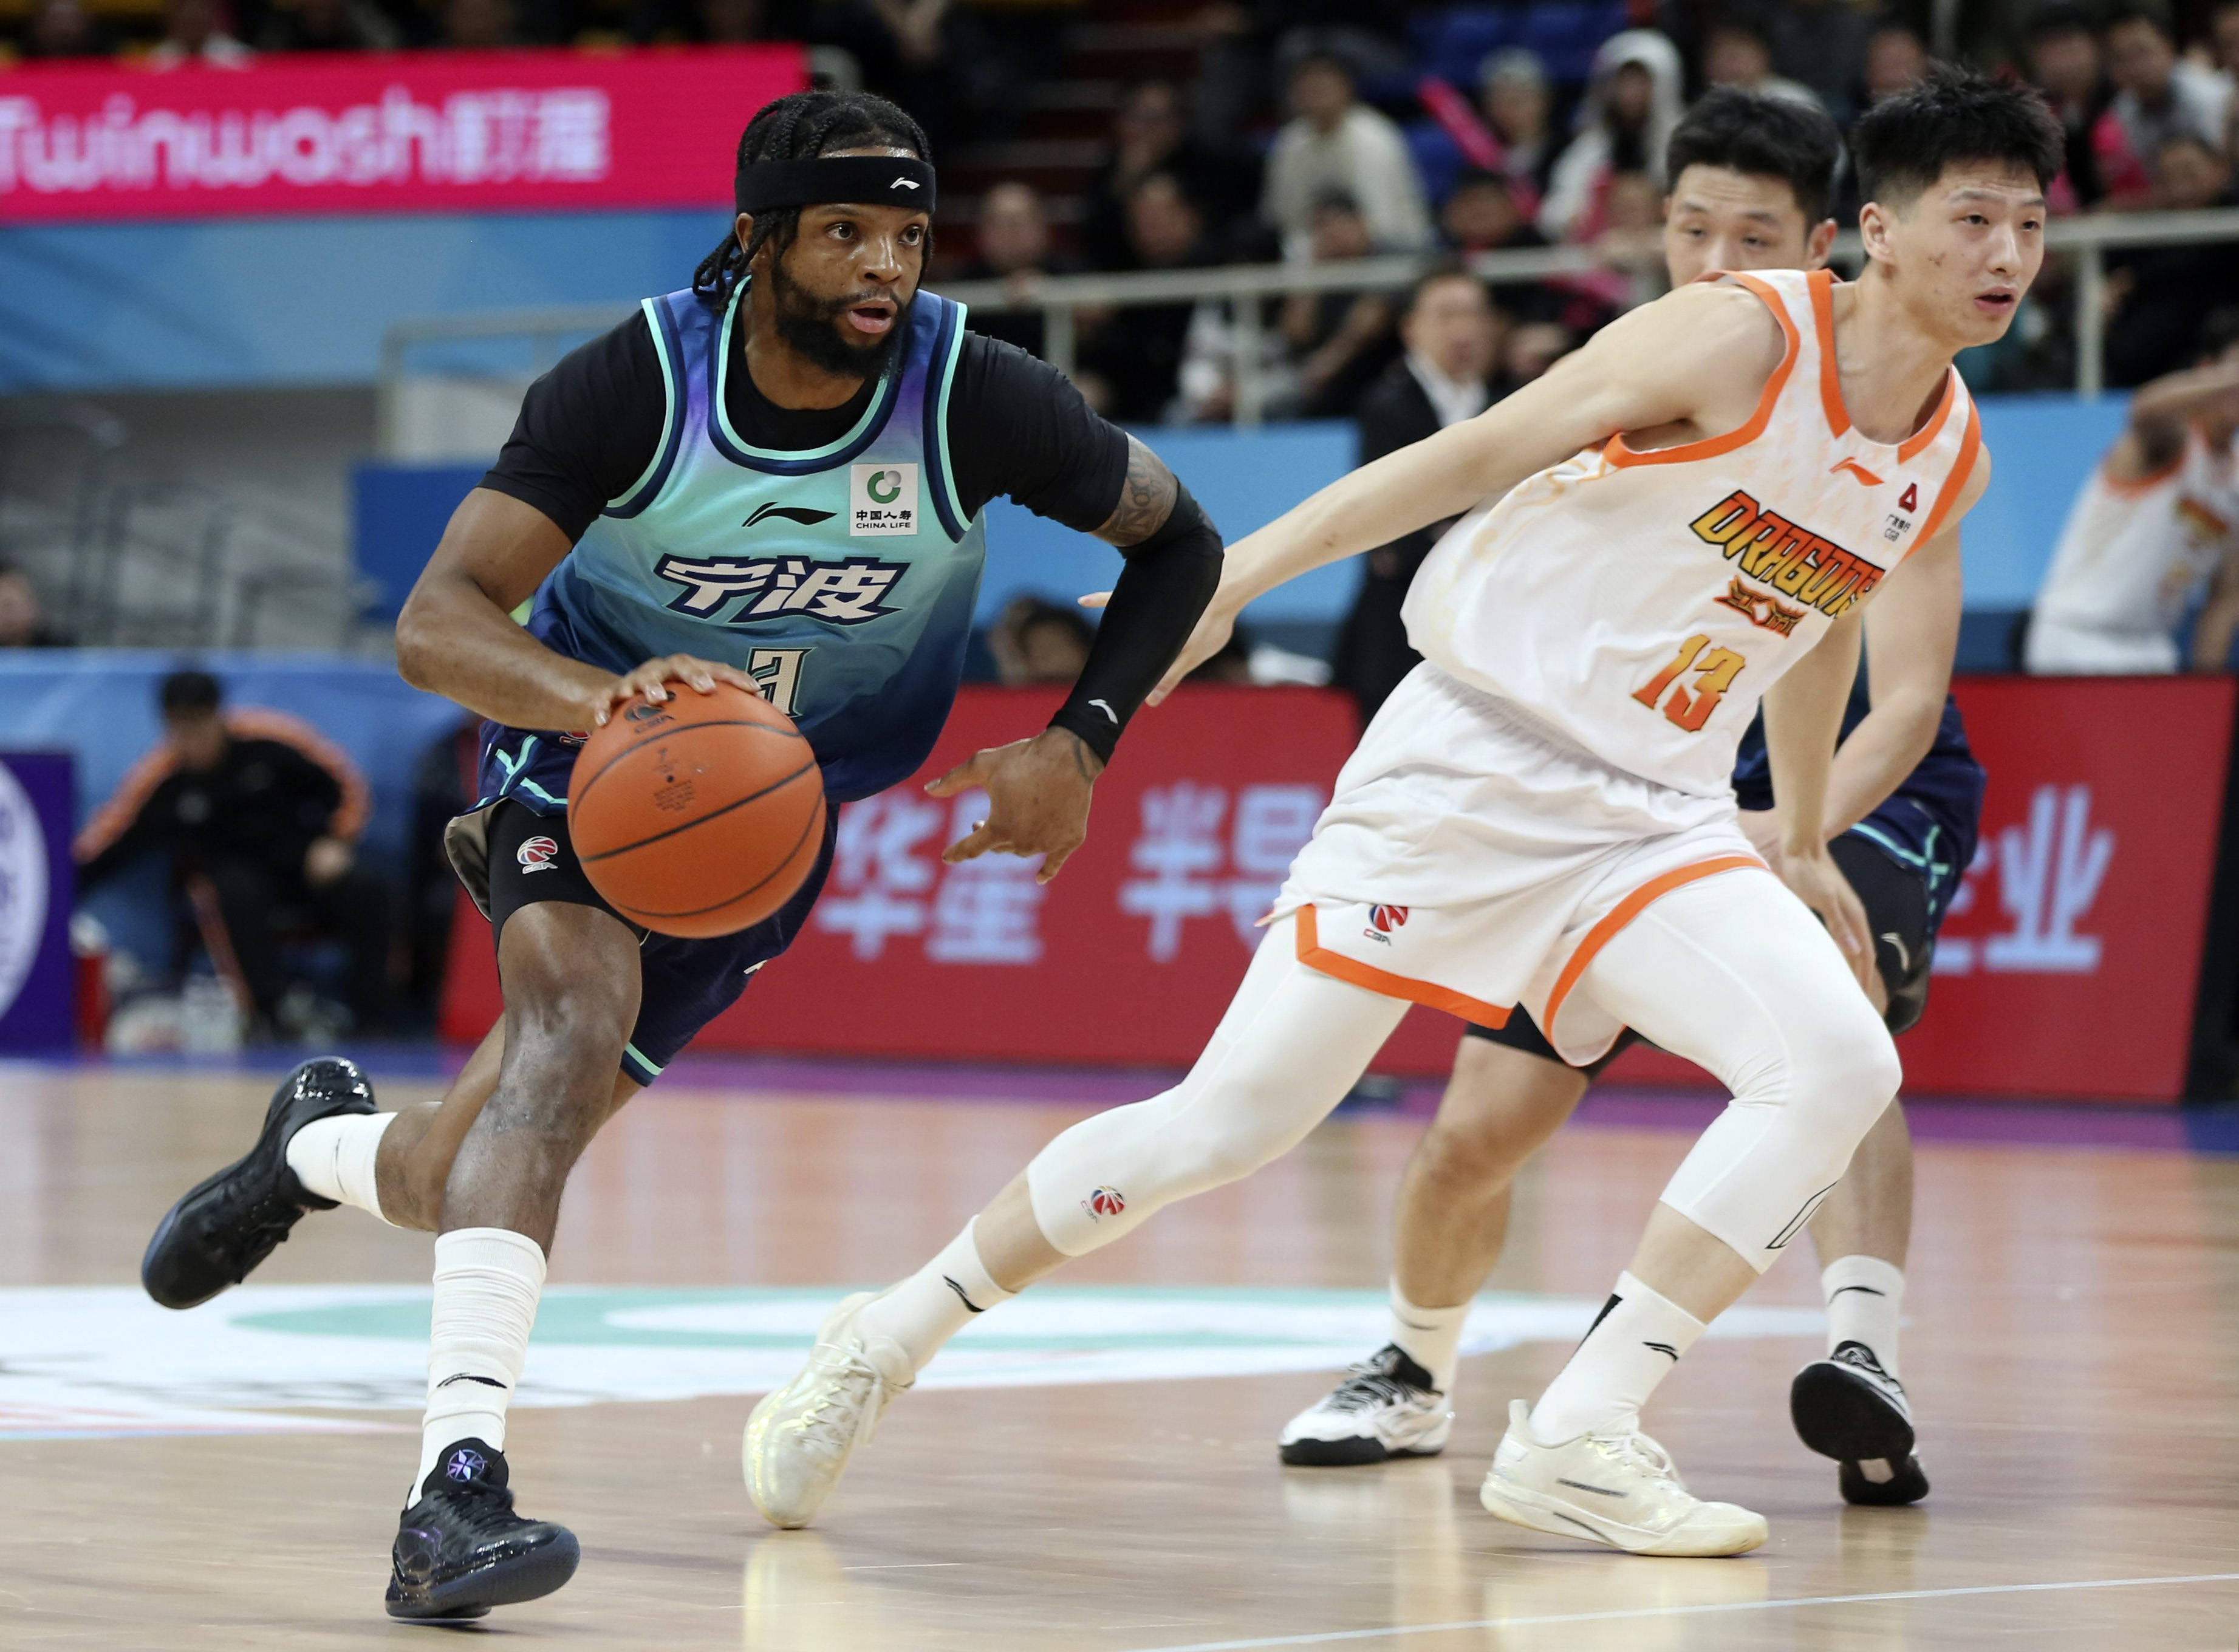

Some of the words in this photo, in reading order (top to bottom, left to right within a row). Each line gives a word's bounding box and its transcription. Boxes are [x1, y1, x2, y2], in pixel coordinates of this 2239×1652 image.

[856, 510, 912, 521] 中国人寿
[655, 553, 909, 624] 宁波
[1631, 634, 1746, 732] 13
